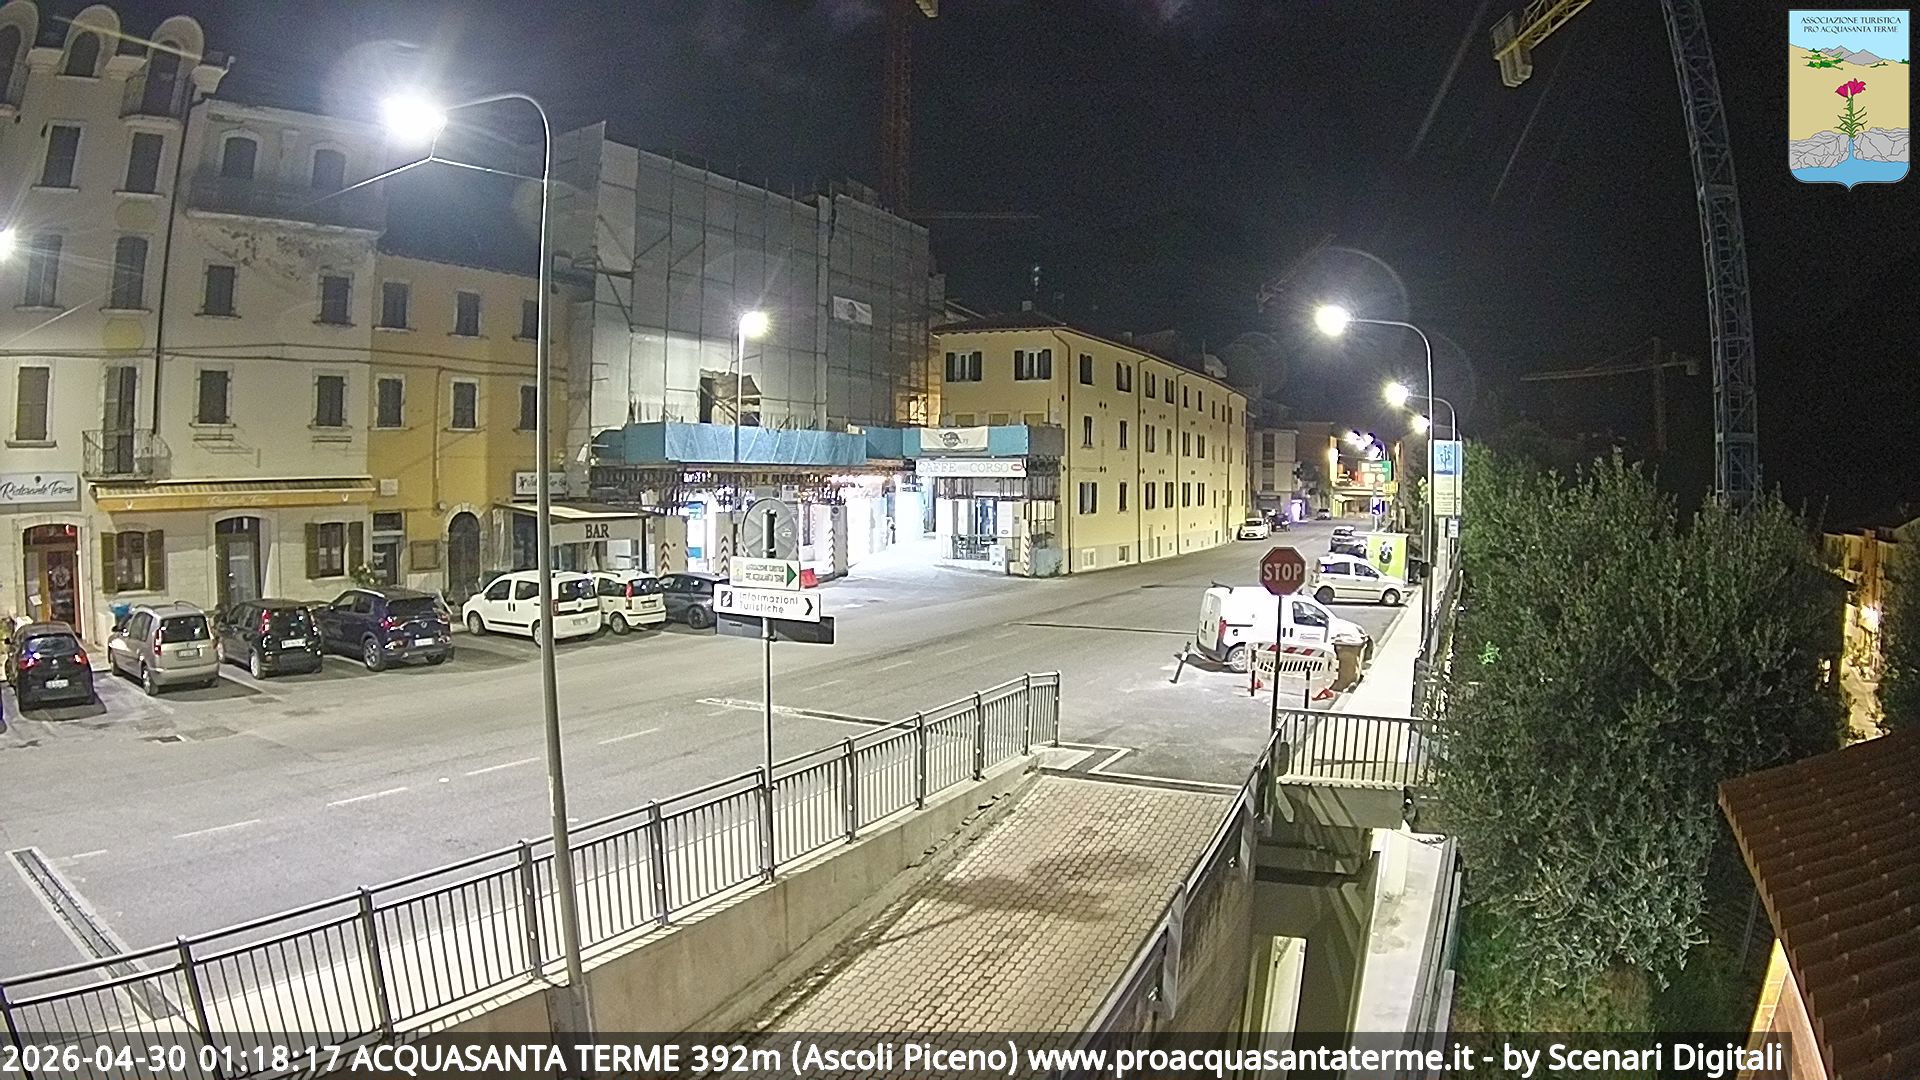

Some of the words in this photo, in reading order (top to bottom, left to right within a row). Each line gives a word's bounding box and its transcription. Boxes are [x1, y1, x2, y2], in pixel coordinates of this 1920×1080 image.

[969, 462, 1009, 473] CORSO
[585, 523, 610, 539] BAR
[1263, 562, 1303, 581] STOP
[739, 592, 799, 605] Informazioni
[739, 600, 784, 614] Turistiche
